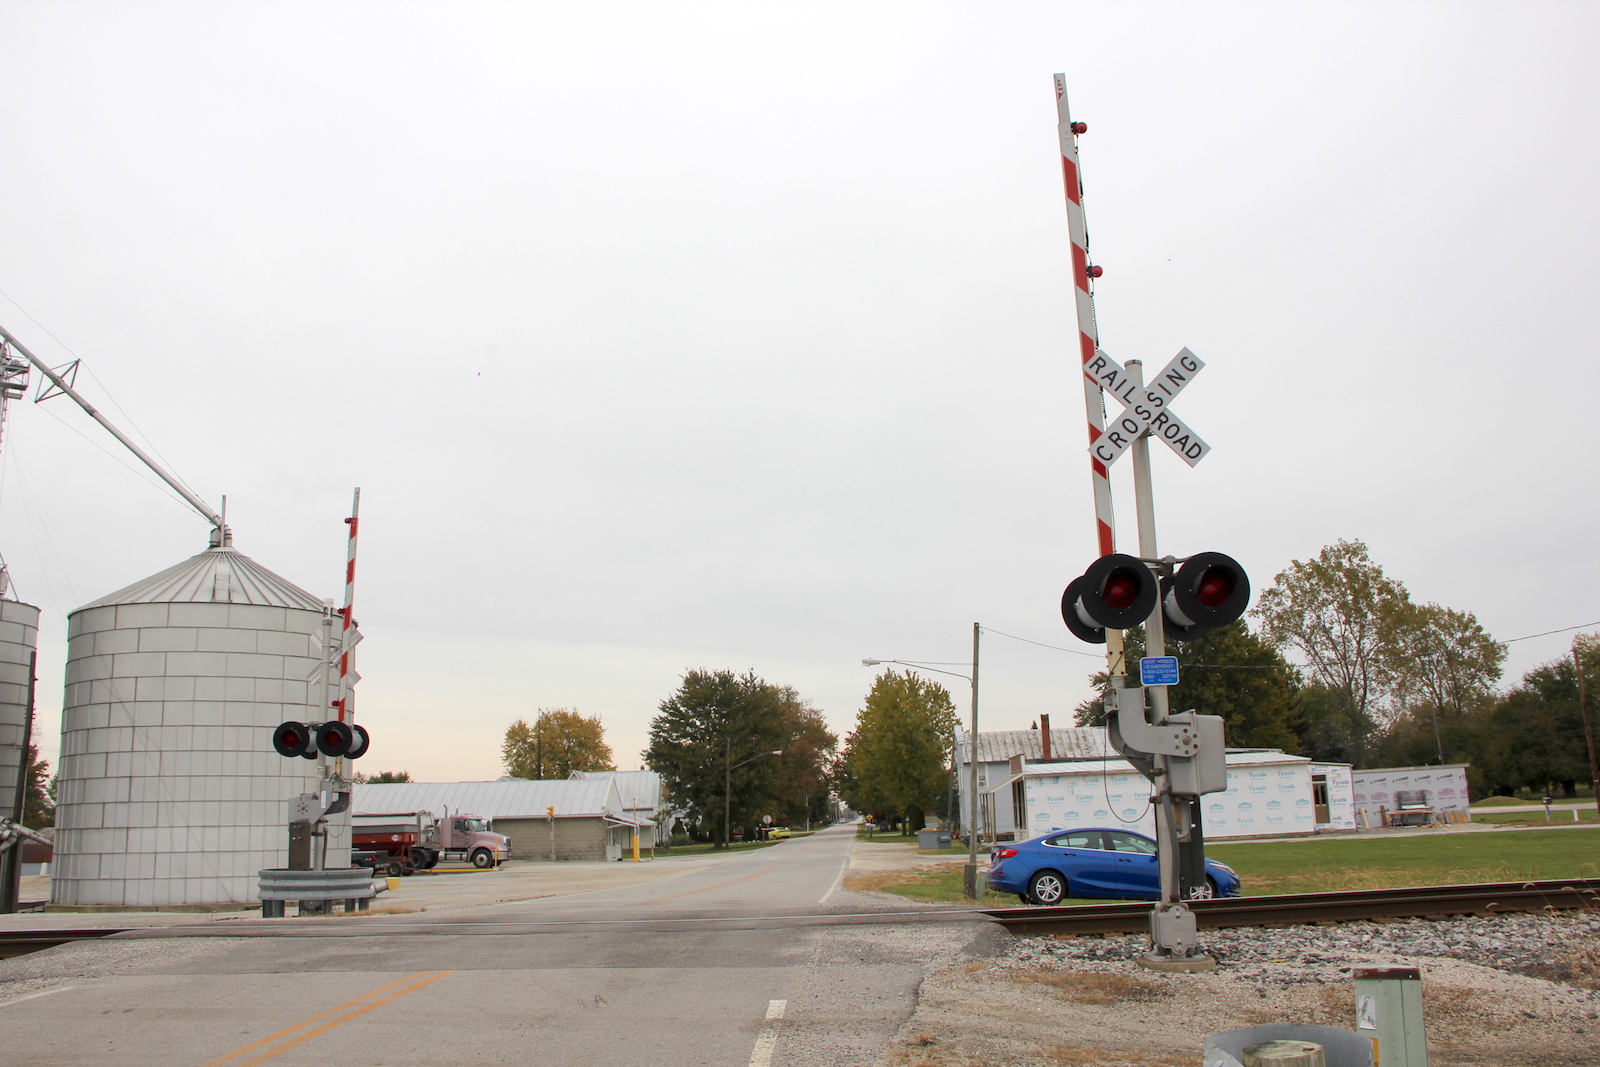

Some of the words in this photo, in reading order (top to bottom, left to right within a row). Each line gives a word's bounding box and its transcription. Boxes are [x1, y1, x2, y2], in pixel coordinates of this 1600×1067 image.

[1088, 356, 1136, 404] RAIL
[1150, 411, 1202, 460] ROAD
[1096, 356, 1197, 462] CROSSING
